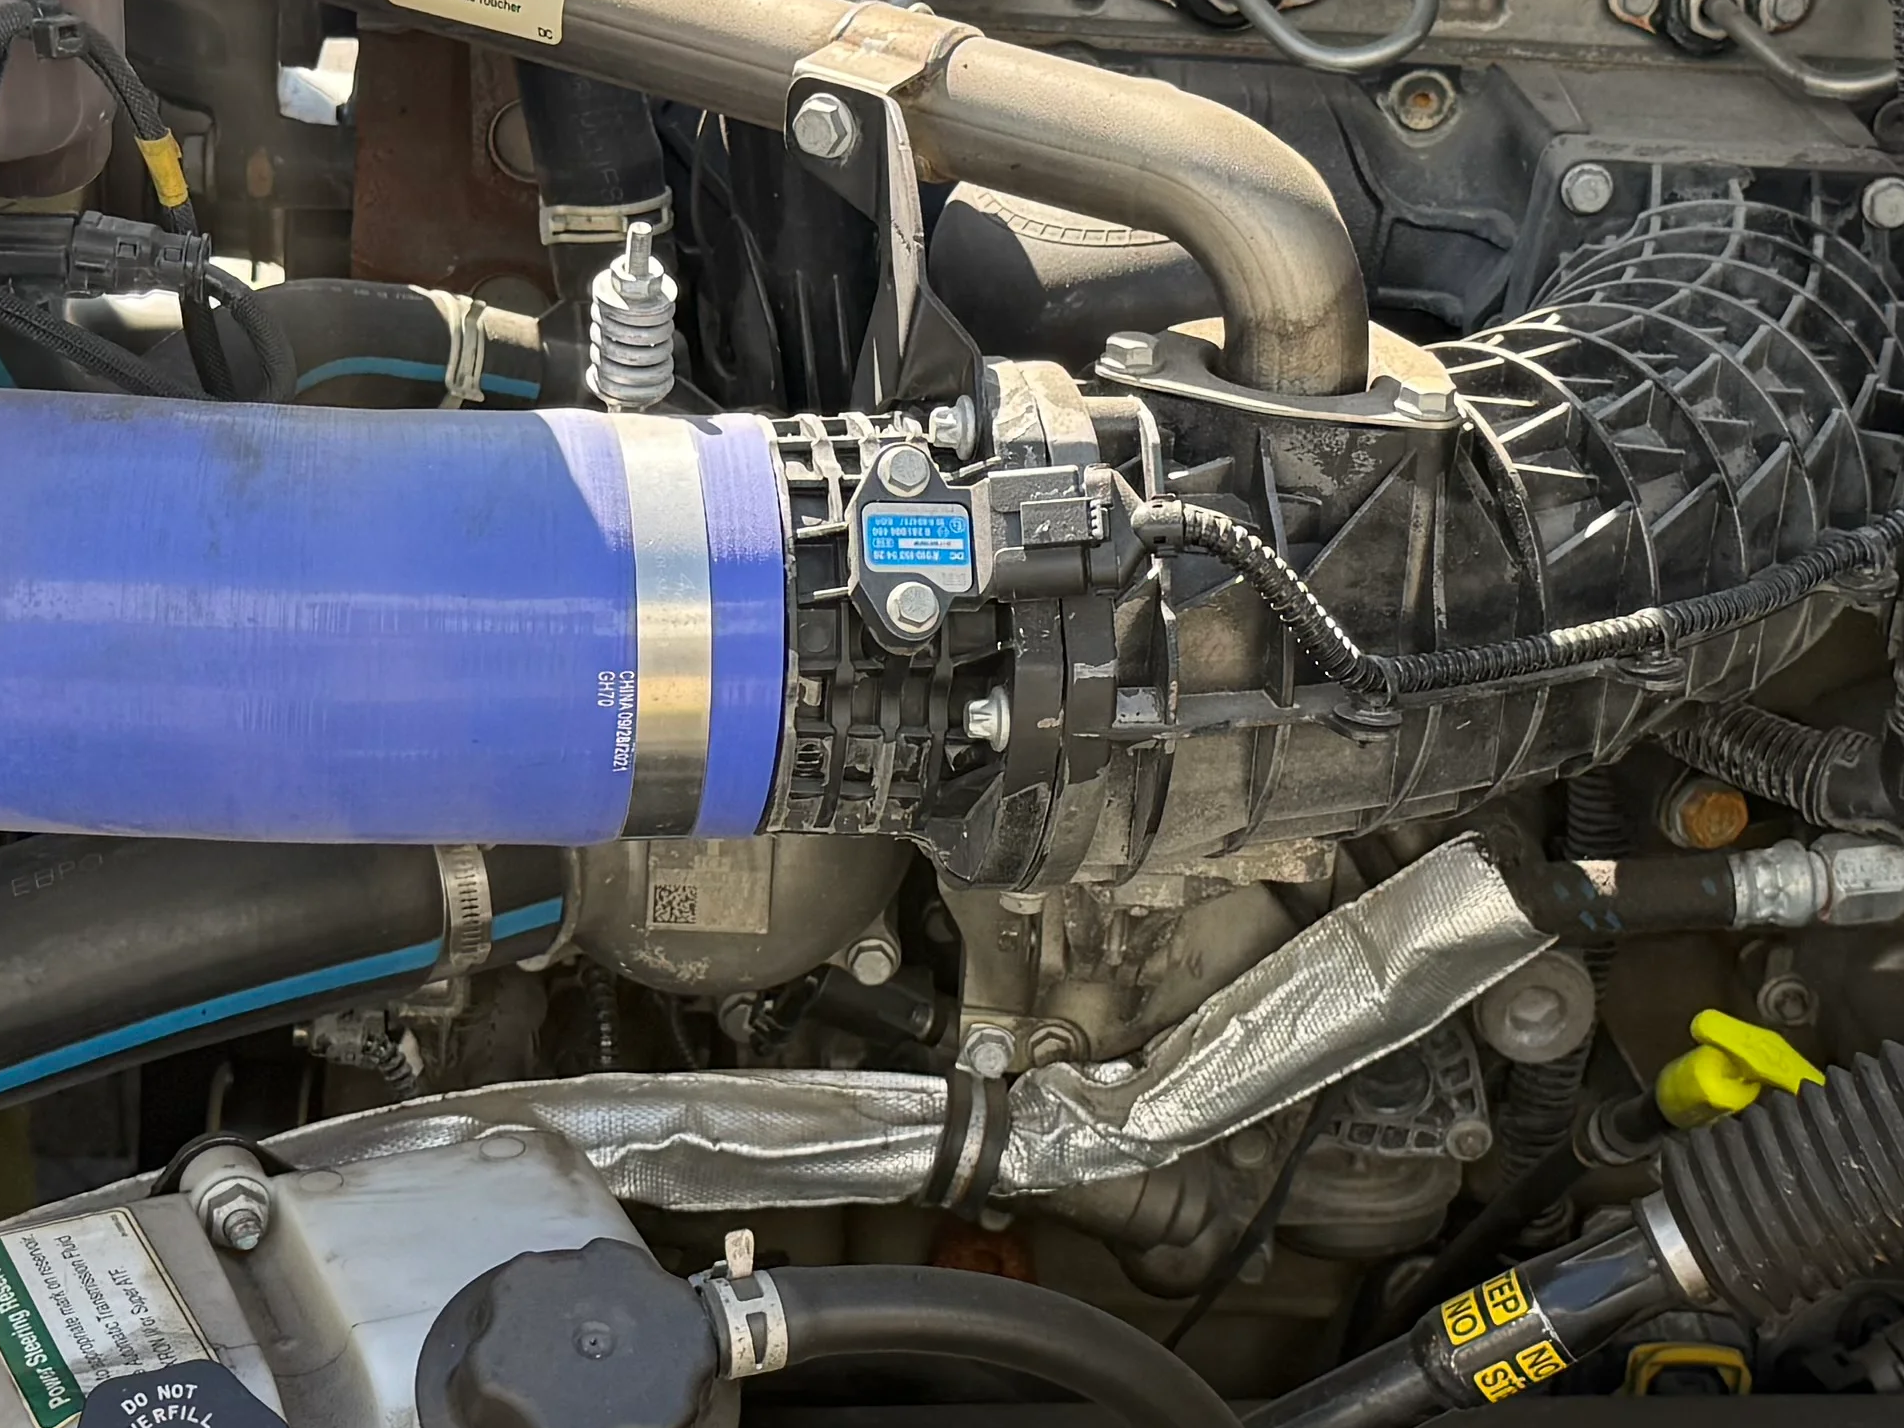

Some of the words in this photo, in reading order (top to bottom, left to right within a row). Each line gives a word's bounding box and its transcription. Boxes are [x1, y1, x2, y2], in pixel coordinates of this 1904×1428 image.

[538, 27, 553, 40] DC
[597, 671, 615, 706] GH70
[619, 671, 635, 710] CHINA
[54, 1234, 79, 1261] Fluid
[44, 1276, 61, 1291] on
[71, 1255, 114, 1323] Transmission
[108, 1265, 134, 1287] ATF.
[48, 1289, 74, 1316] mark
[122, 1287, 149, 1316] Super
[1445, 1296, 1478, 1336] NO
[9, 1309, 49, 1368] Steering
[1522, 1346, 1560, 1378] NO
[37, 1366, 71, 1410] Power
[120, 1391, 149, 1416] DO
[157, 1383, 199, 1400] NOT
